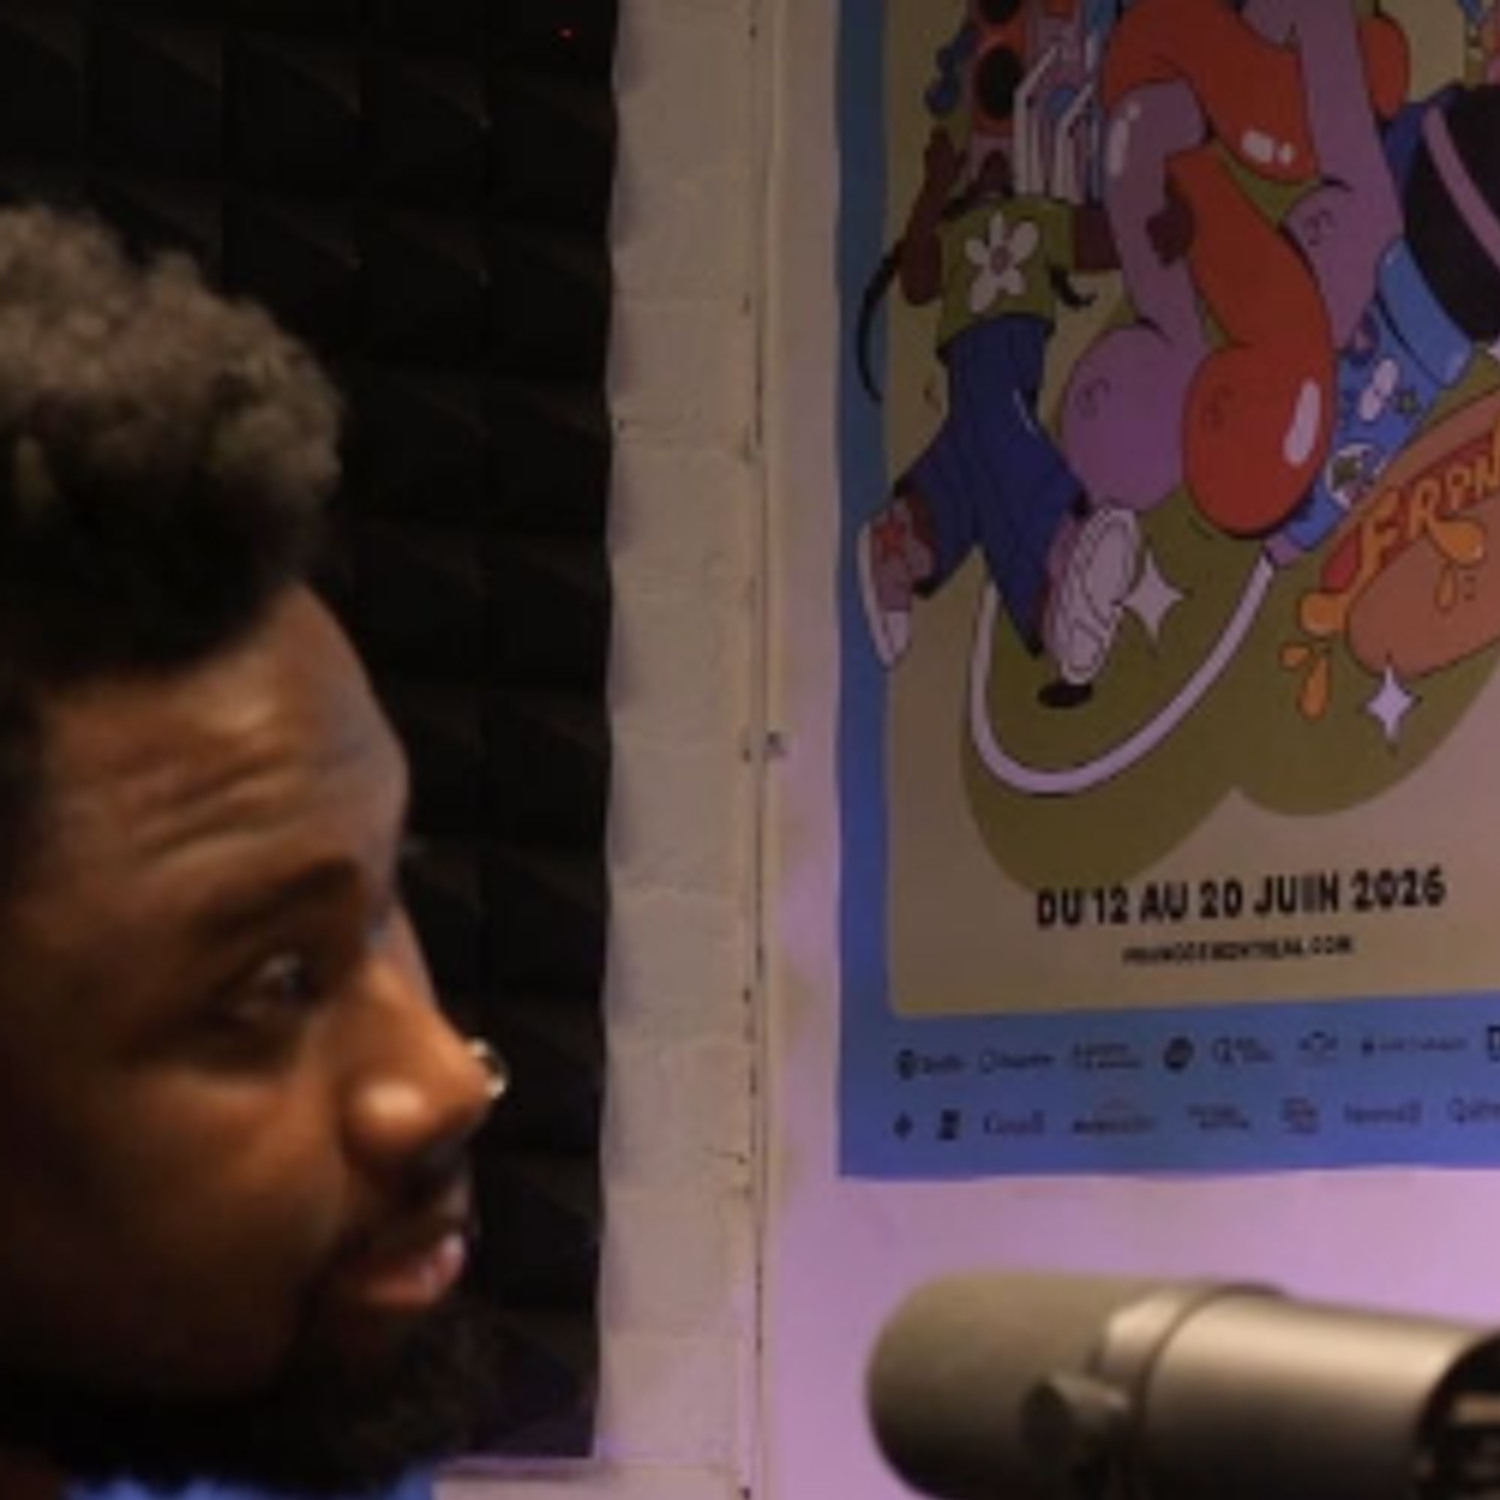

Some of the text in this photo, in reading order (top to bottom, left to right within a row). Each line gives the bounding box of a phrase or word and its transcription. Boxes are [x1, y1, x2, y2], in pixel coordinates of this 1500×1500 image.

[1038, 866, 1447, 928] DU 12 AU 20 JUIN 2026
